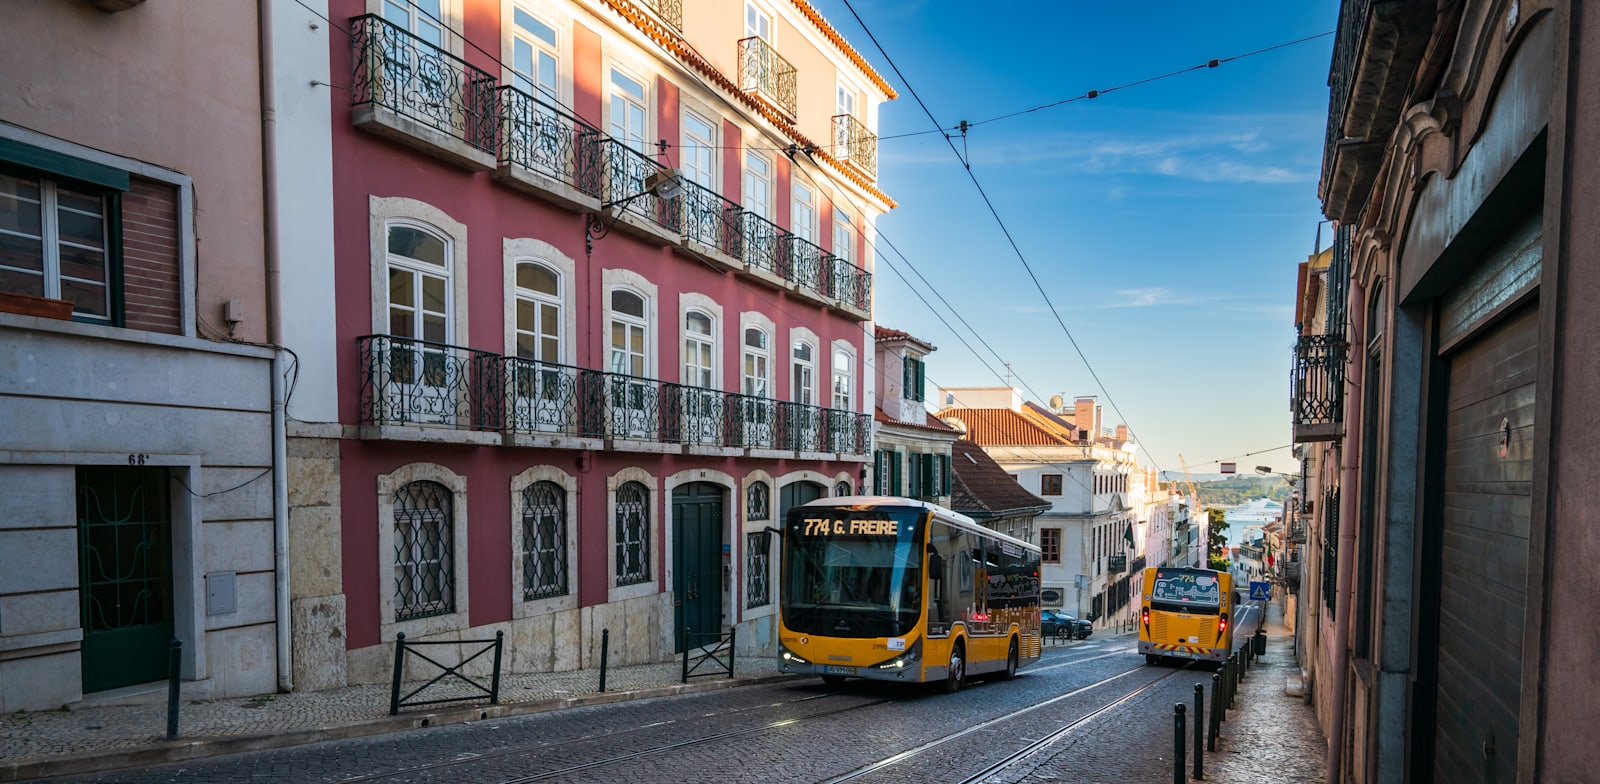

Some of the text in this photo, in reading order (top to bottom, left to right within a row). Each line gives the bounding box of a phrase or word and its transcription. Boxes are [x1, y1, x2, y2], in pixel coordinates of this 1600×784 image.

[803, 518, 899, 536] 774 G. FREIRE
[1179, 574, 1196, 584] 774
